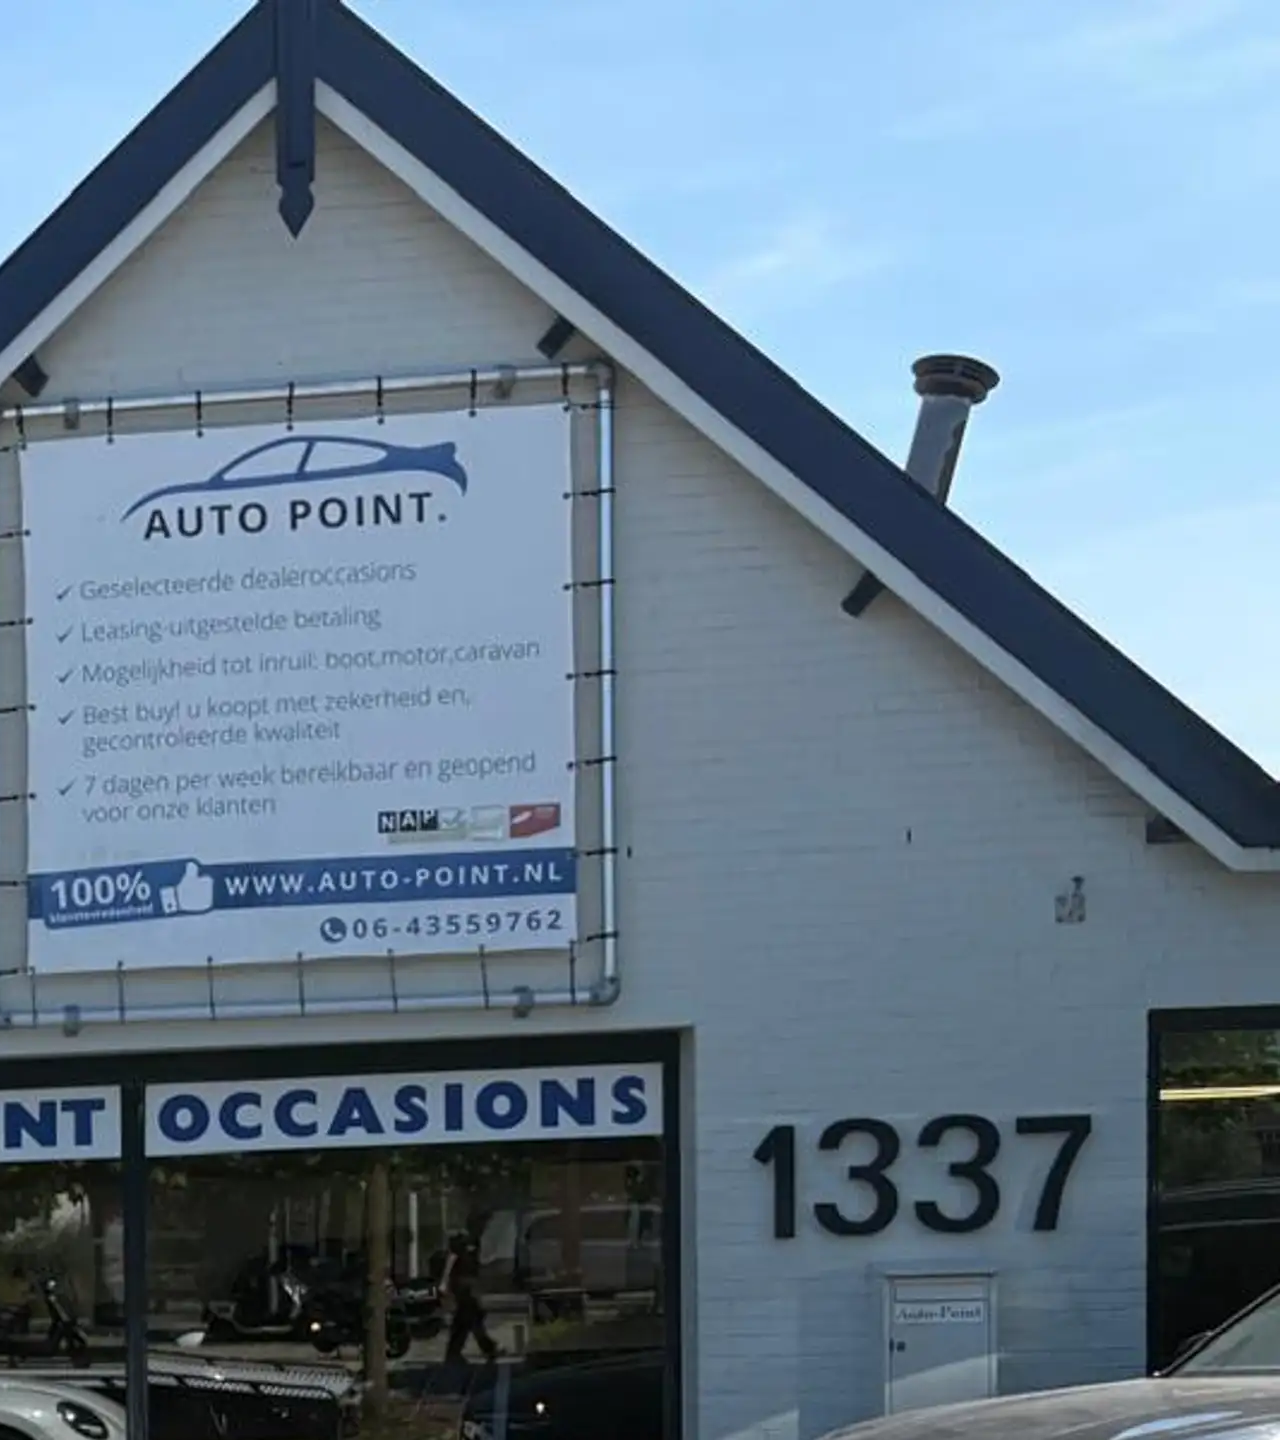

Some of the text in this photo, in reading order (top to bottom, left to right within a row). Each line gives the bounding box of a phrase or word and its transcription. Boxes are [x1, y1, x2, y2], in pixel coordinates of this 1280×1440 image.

[144, 502, 268, 540] AUTO
[80, 561, 417, 600] Geselecteerde dealeroccasions
[294, 606, 382, 631] betaling
[81, 653, 216, 687] Mogelijkheid
[222, 655, 253, 676] tot
[83, 704, 129, 725] Best
[136, 701, 180, 725] buy!
[188, 704, 202, 719] u
[207, 696, 269, 719] koopt
[275, 694, 318, 713] met
[324, 687, 431, 712] zekerheid
[83, 720, 341, 758] gecontroleerde kwaliteit
[85, 753, 536, 798] 7 dagen per week bereikbaar en geopend
[82, 796, 276, 824] voor onze klanten
[379, 808, 438, 834] NAP
[51, 861, 564, 909] 100% WWW.AUTO-POINT.NL
[353, 909, 563, 939] 06-43559762
[158, 1075, 647, 1142] OCCASIONS
[753, 1113, 1093, 1240] 1337
